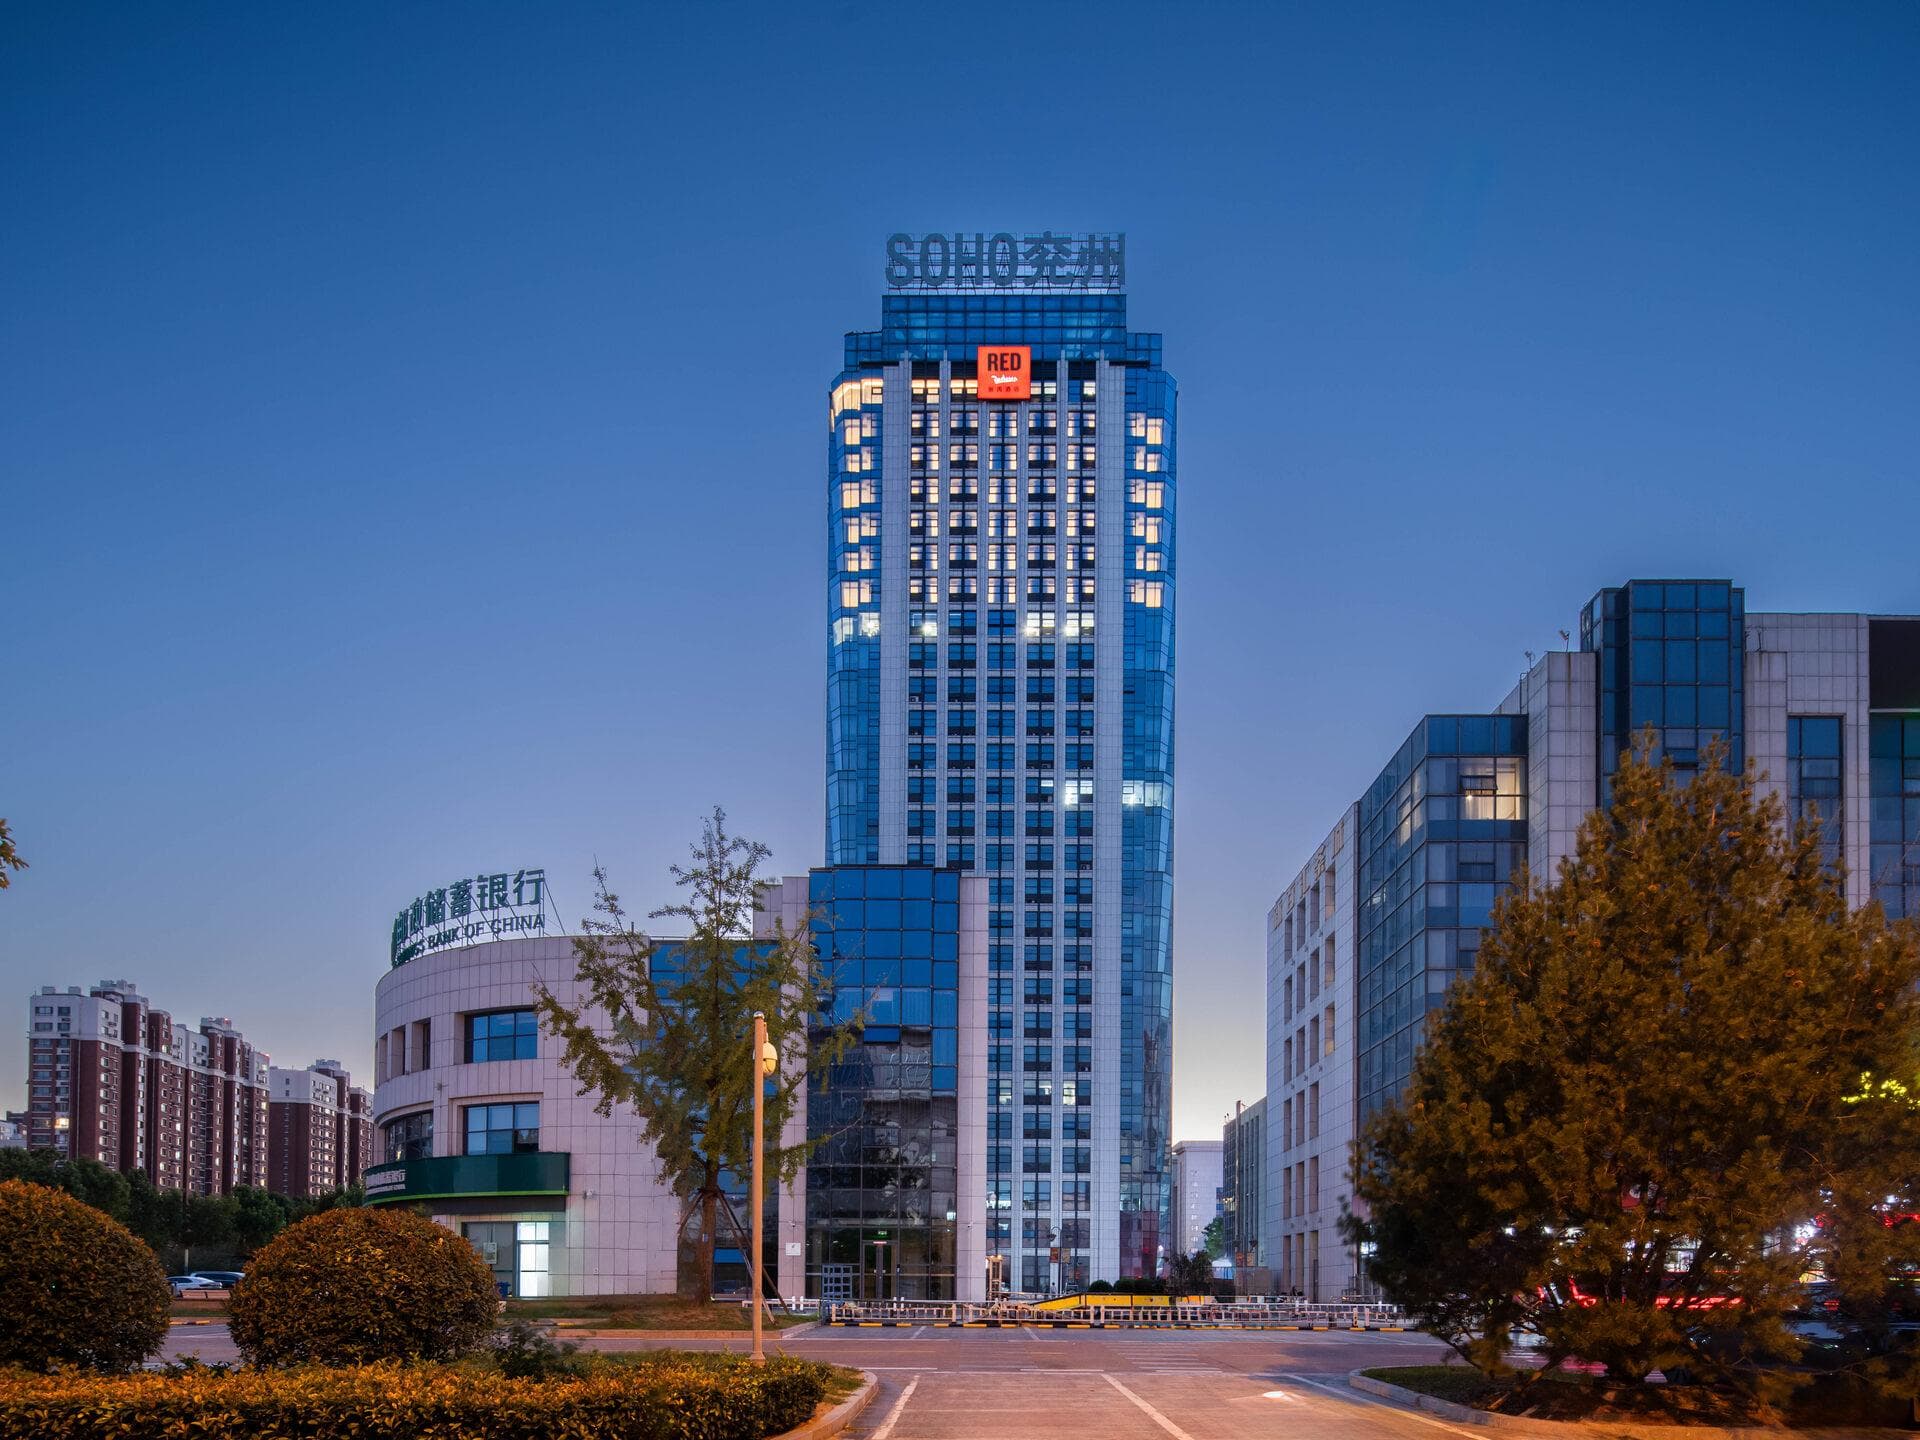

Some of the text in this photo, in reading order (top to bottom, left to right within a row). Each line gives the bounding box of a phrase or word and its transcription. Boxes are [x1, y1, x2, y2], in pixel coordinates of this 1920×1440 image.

[987, 352, 1021, 371] RED
[427, 913, 545, 949] BANK OF CHINA
